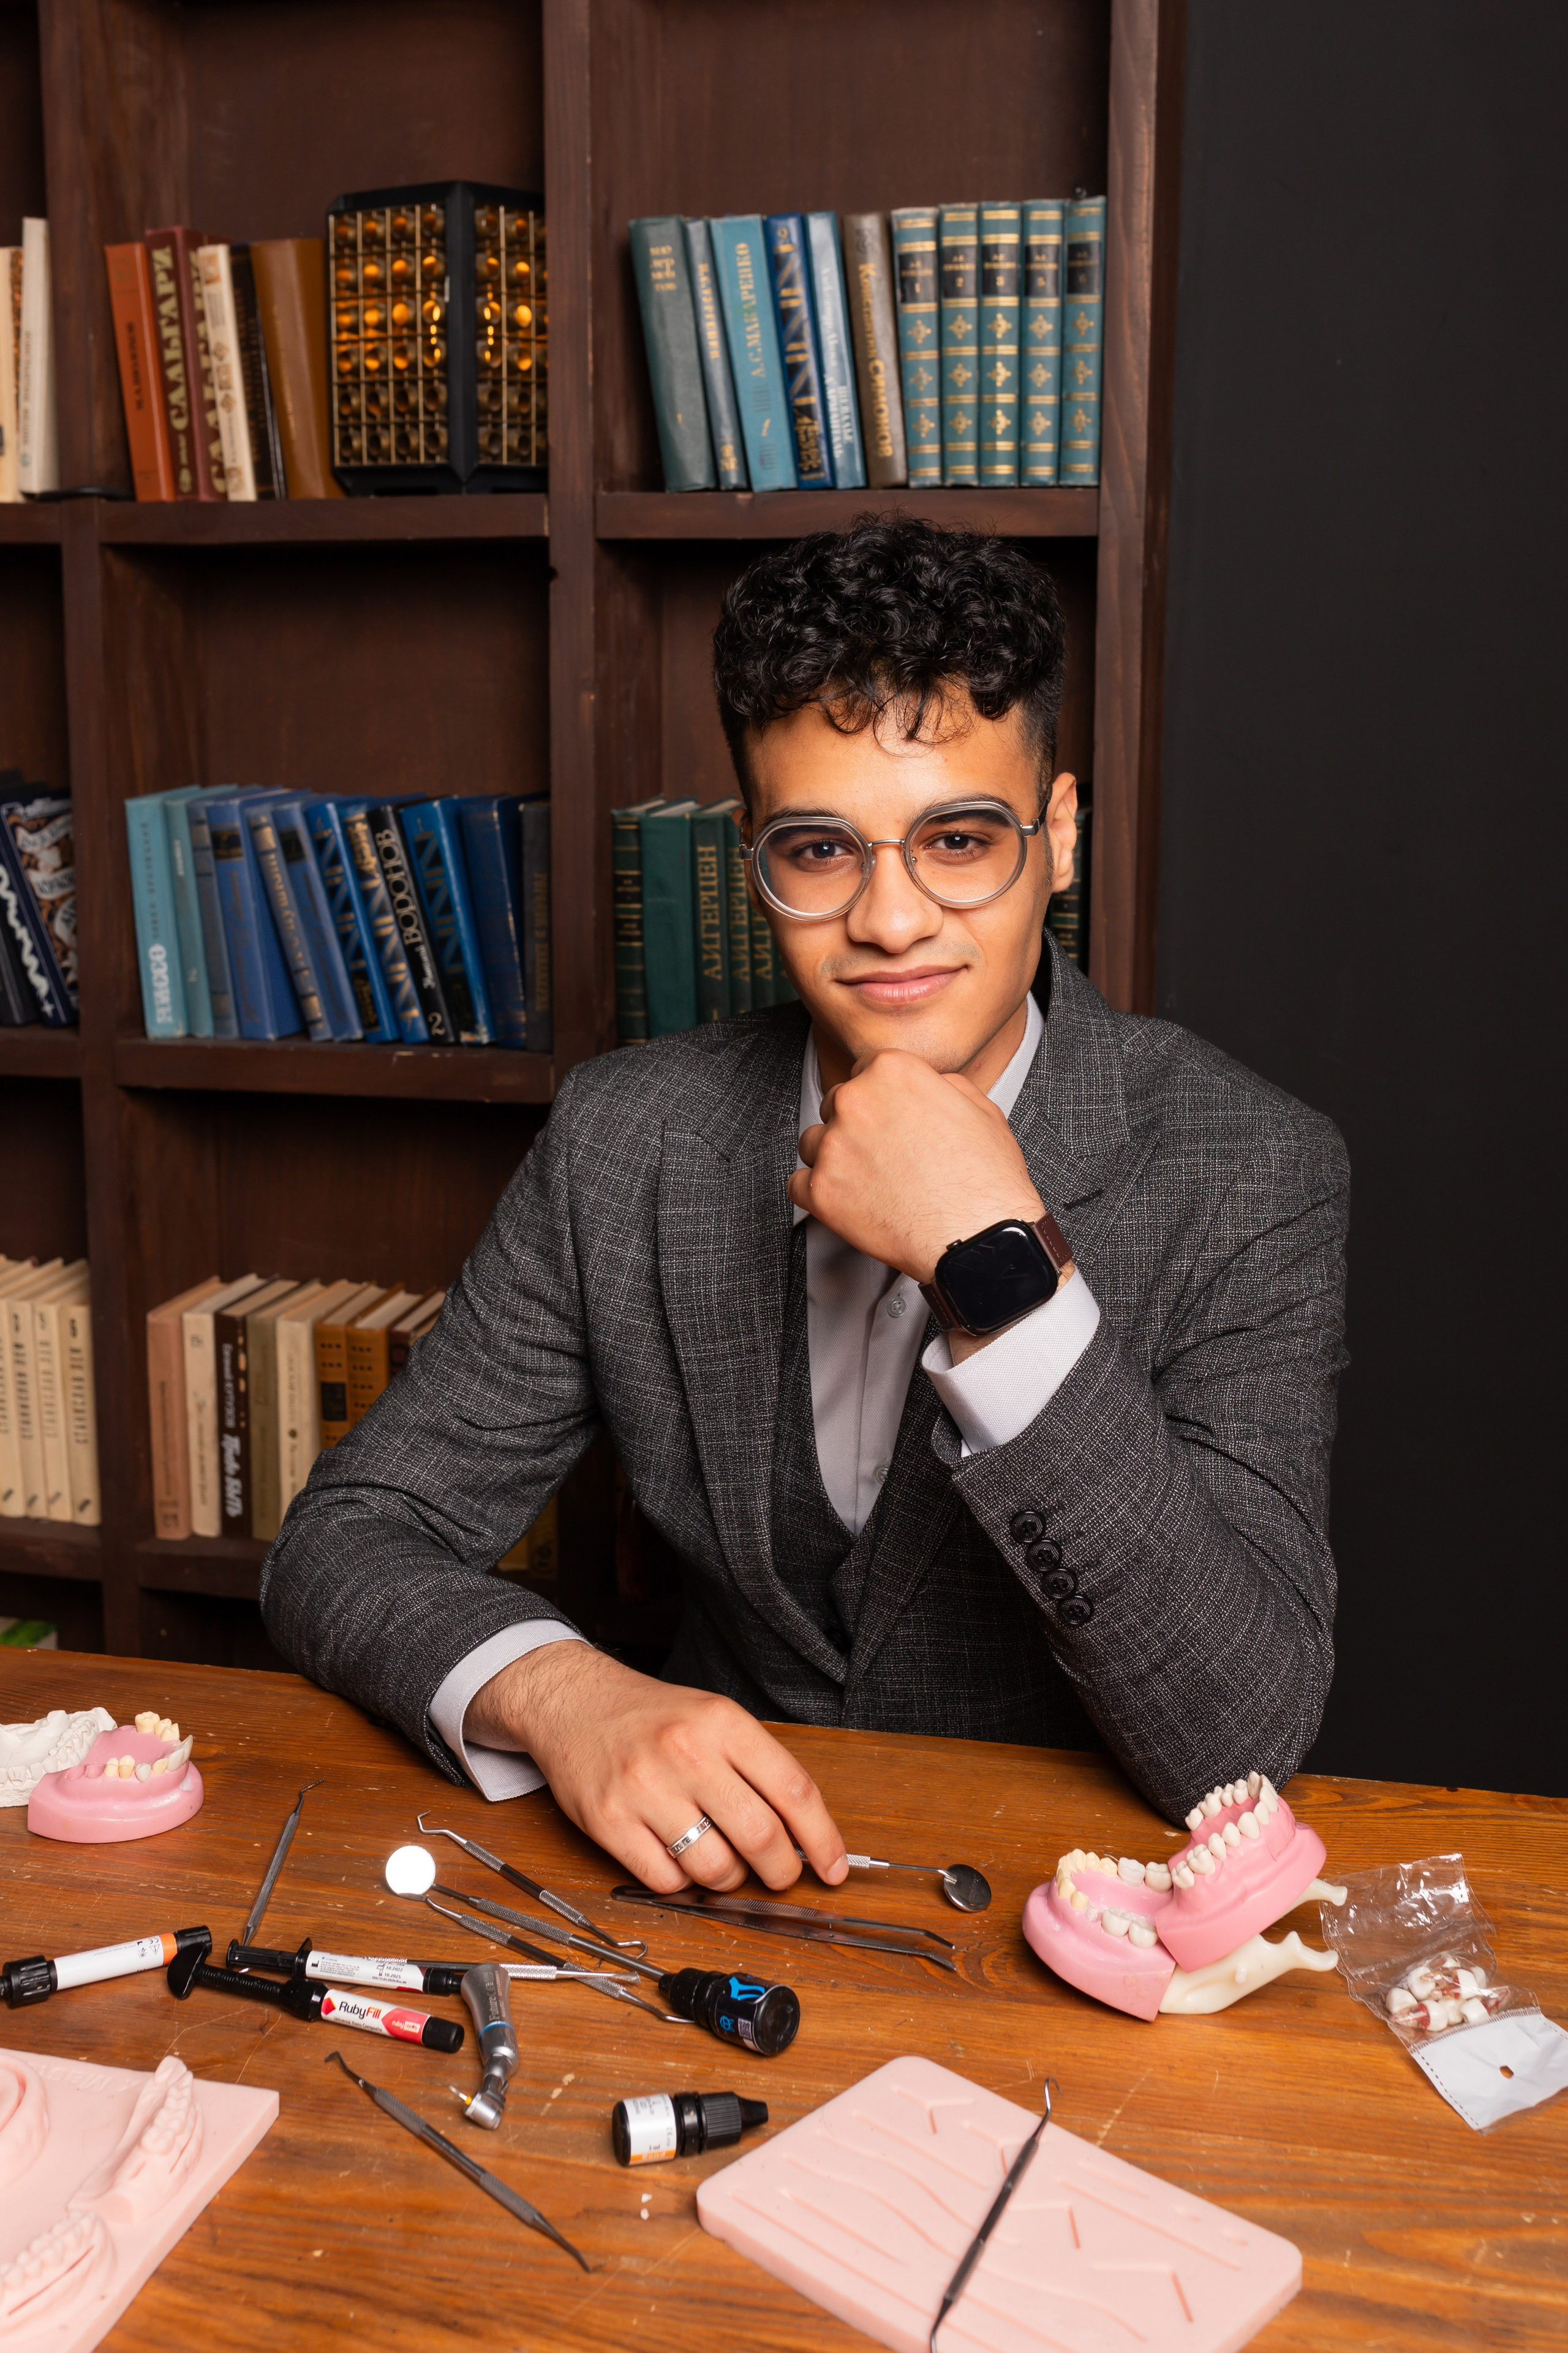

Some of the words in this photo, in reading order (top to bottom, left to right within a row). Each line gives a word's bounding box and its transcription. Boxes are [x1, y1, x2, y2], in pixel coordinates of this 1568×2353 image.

[152, 245, 189, 431] САЛЬГАРИ
[868, 359, 894, 458] СИМОНОВ
[375, 829, 423, 945] ВОРОНОВ
[148, 943, 173, 1024] НИССО
[428, 1011, 446, 1036] 2
[339, 2001, 382, 2019] RubyFill
[489, 1996, 500, 2021] Future
[334, 2016, 351, 2025] Universal
[363, 2023, 383, 2033] Composite
[391, 2020, 404, 2030] ruby
